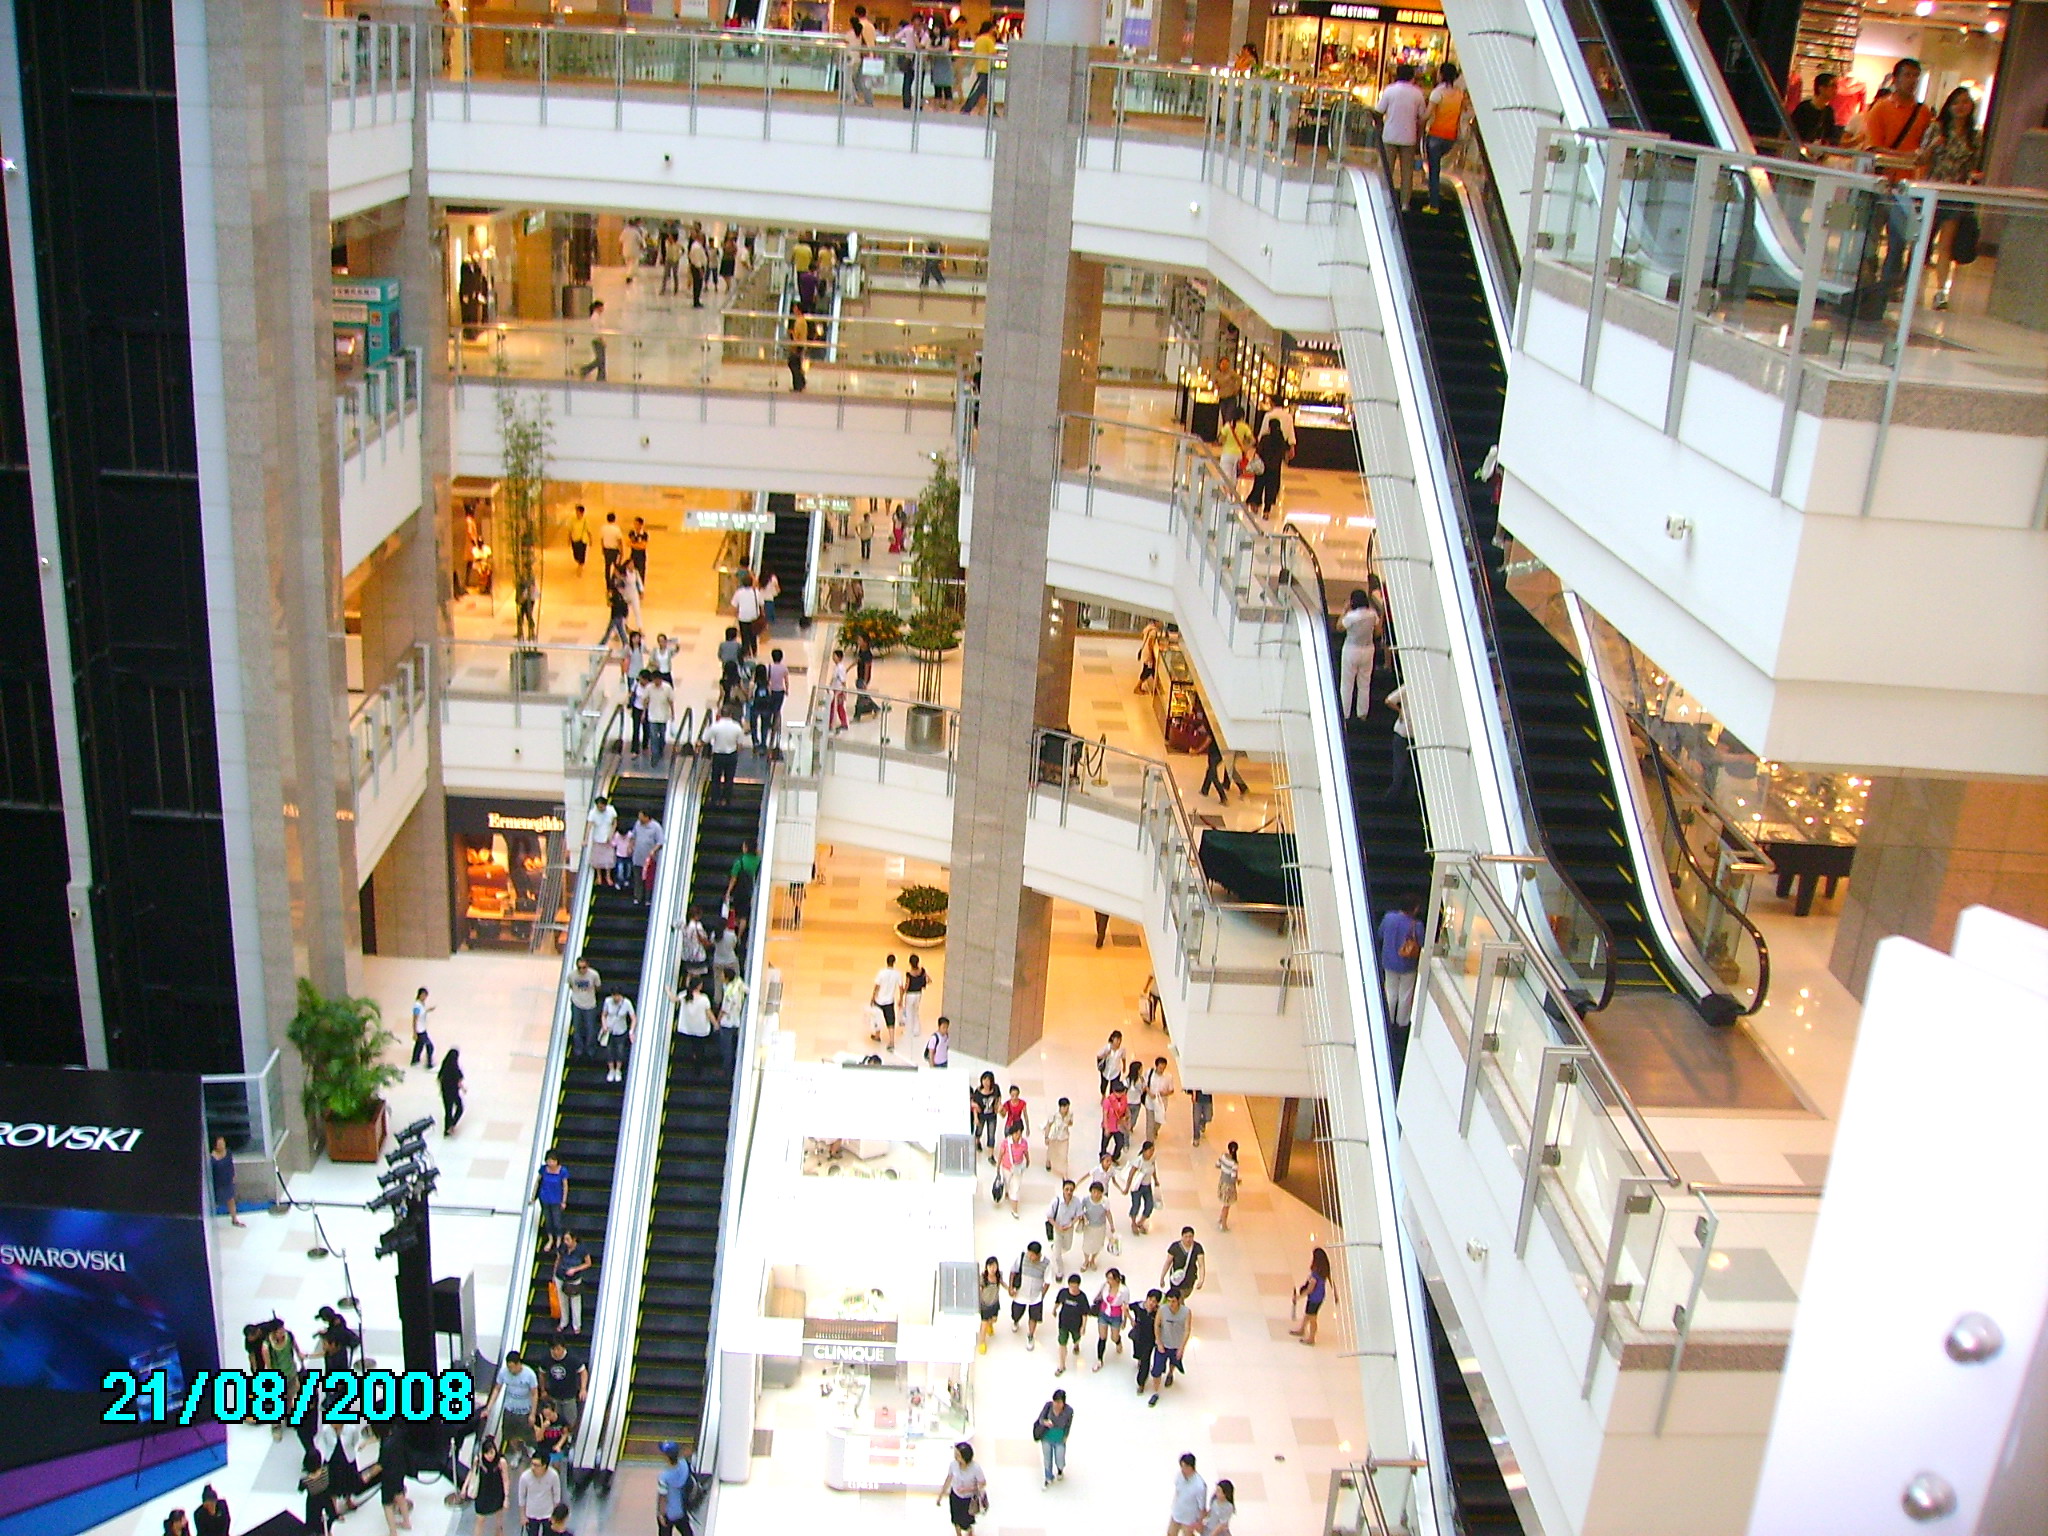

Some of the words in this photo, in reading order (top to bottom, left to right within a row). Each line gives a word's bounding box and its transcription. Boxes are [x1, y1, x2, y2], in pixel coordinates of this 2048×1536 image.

[488, 812, 564, 833] Ermenegildo
[0, 1244, 127, 1272] SWAROVSKI
[814, 1345, 884, 1362] CLINIQUE
